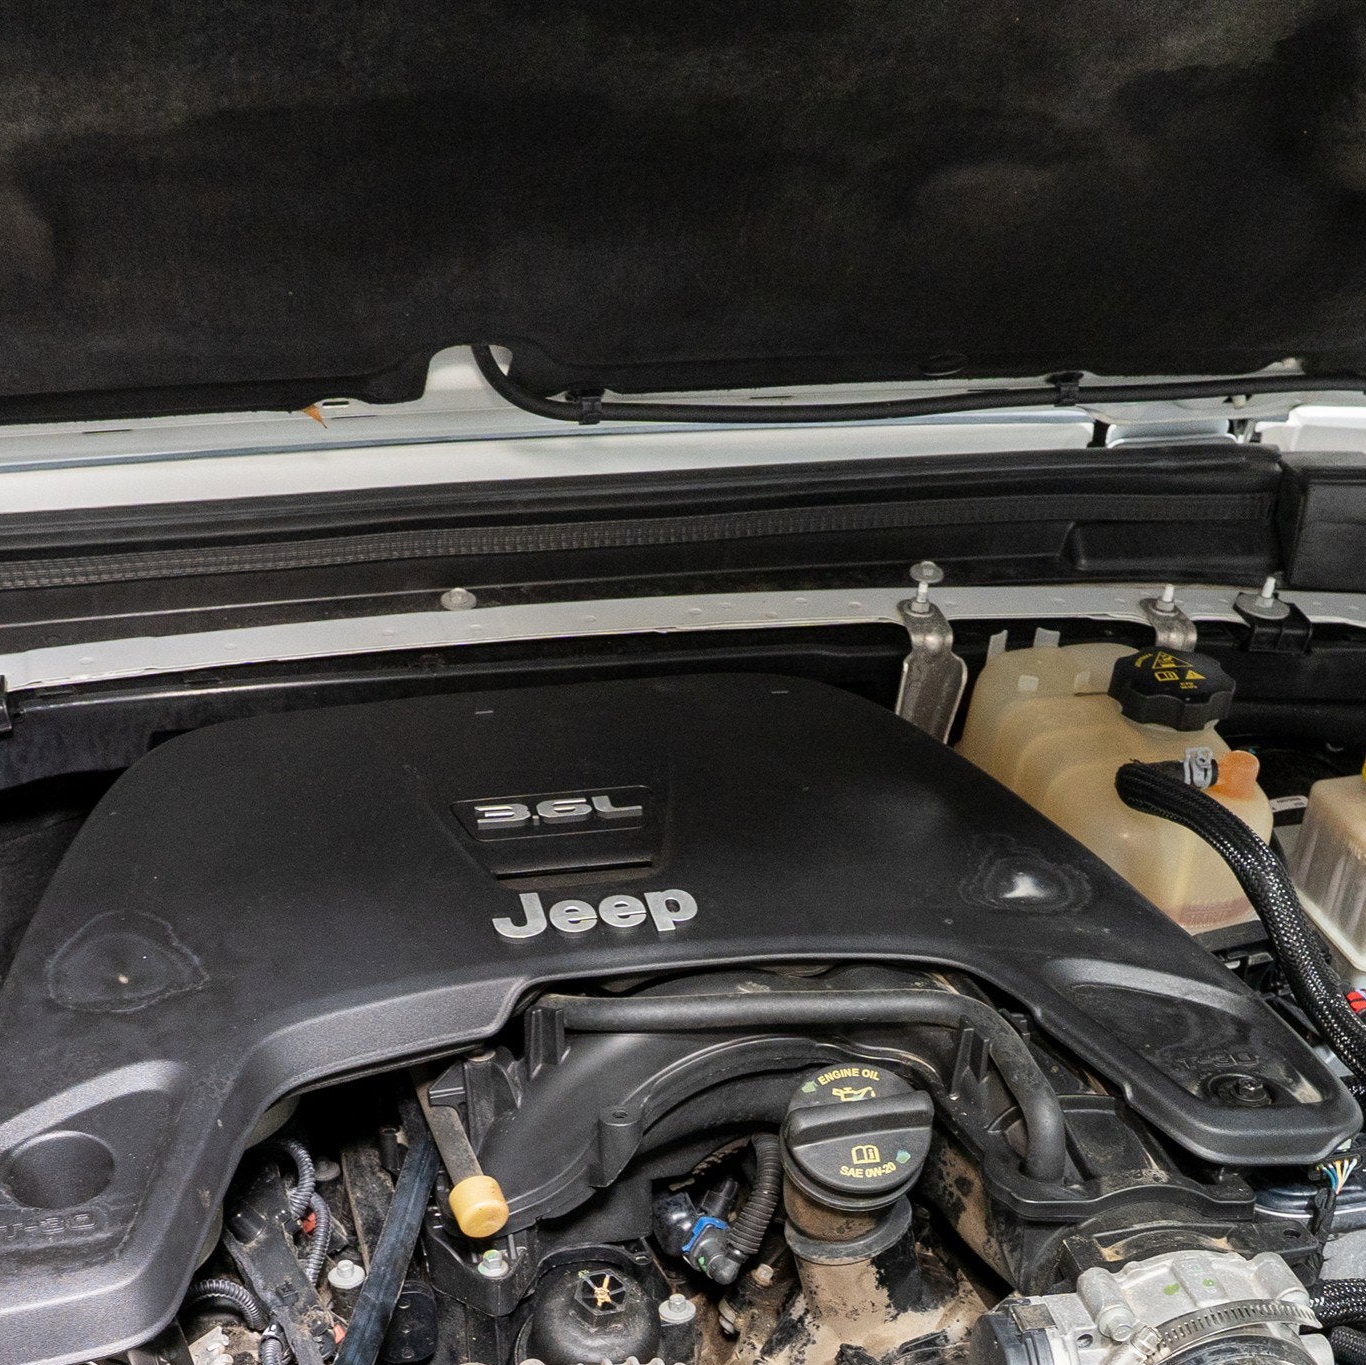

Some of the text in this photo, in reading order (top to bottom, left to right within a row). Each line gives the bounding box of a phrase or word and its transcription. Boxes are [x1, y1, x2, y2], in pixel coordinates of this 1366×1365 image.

[474, 795, 643, 829] 3.6L
[492, 888, 698, 939] Jeep
[817, 1068, 881, 1086] ENGINE OIL
[839, 1165, 864, 1178] SAE
